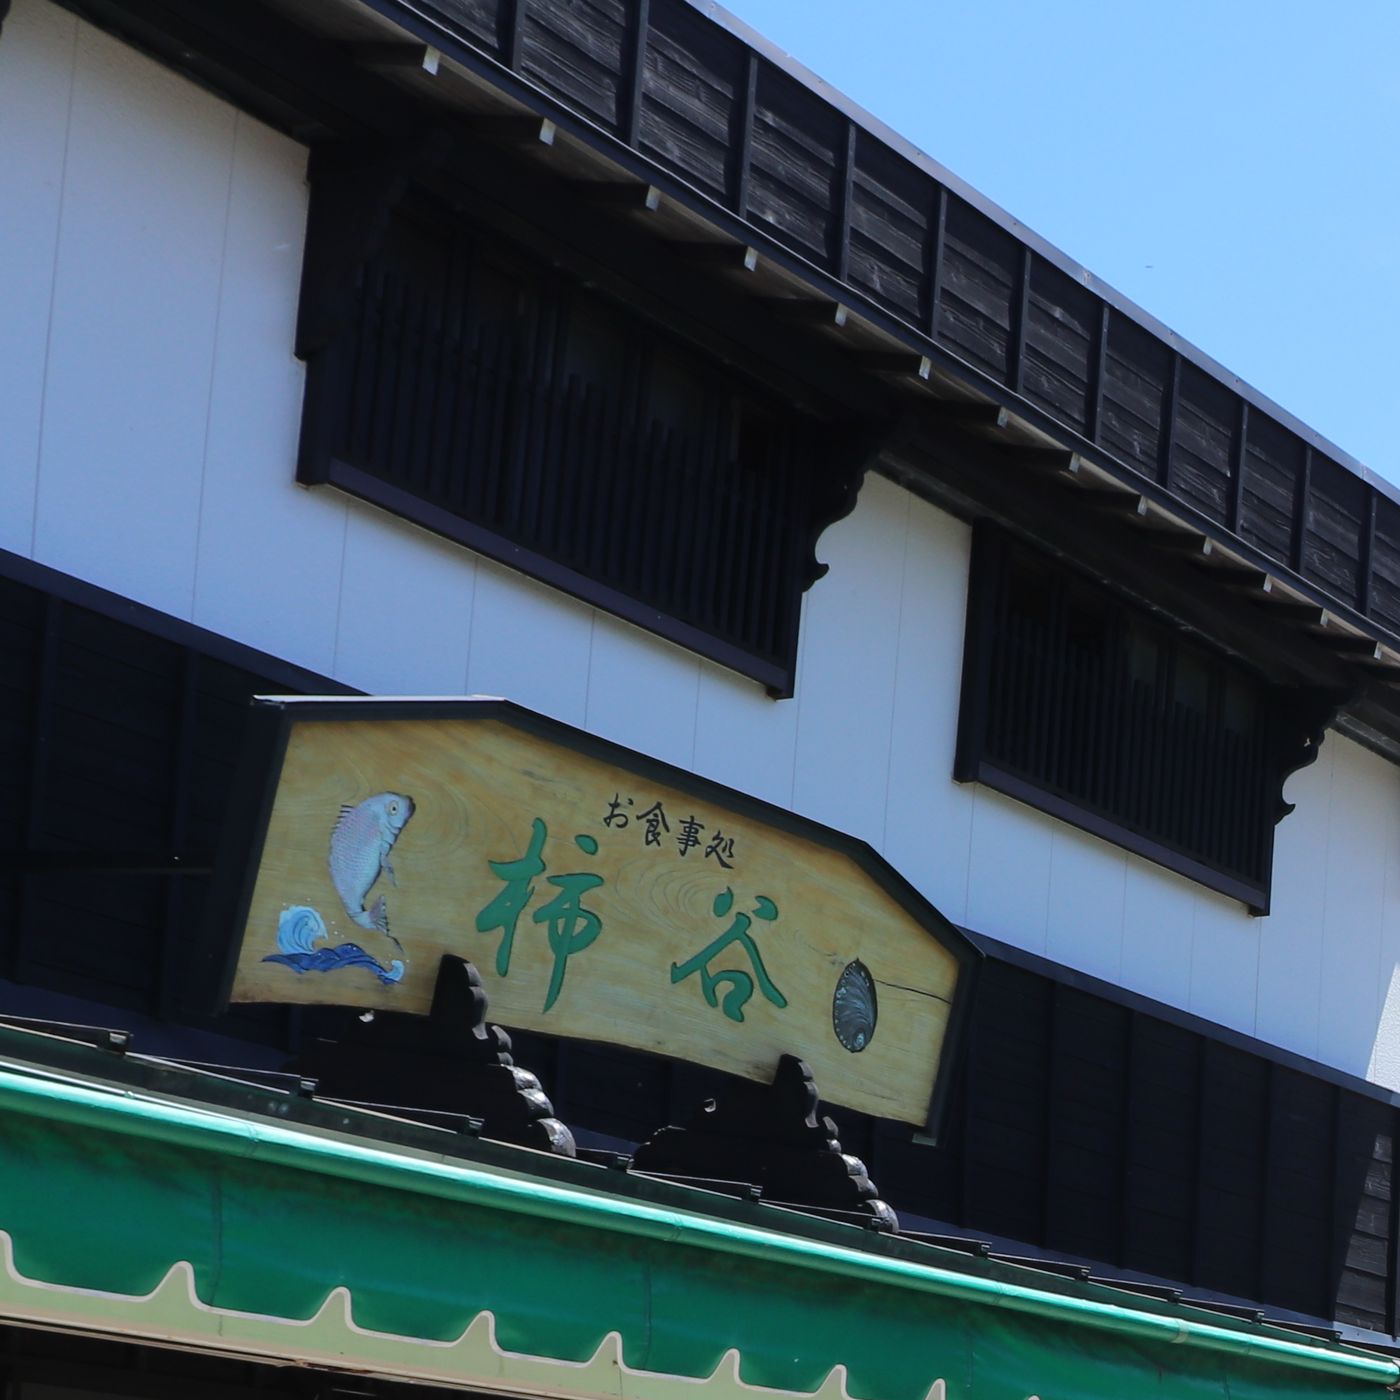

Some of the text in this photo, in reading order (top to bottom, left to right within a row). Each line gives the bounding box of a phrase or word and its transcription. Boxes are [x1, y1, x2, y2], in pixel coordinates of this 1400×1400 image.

[604, 793, 736, 869] お食事処
[476, 817, 788, 1023] 柿谷
